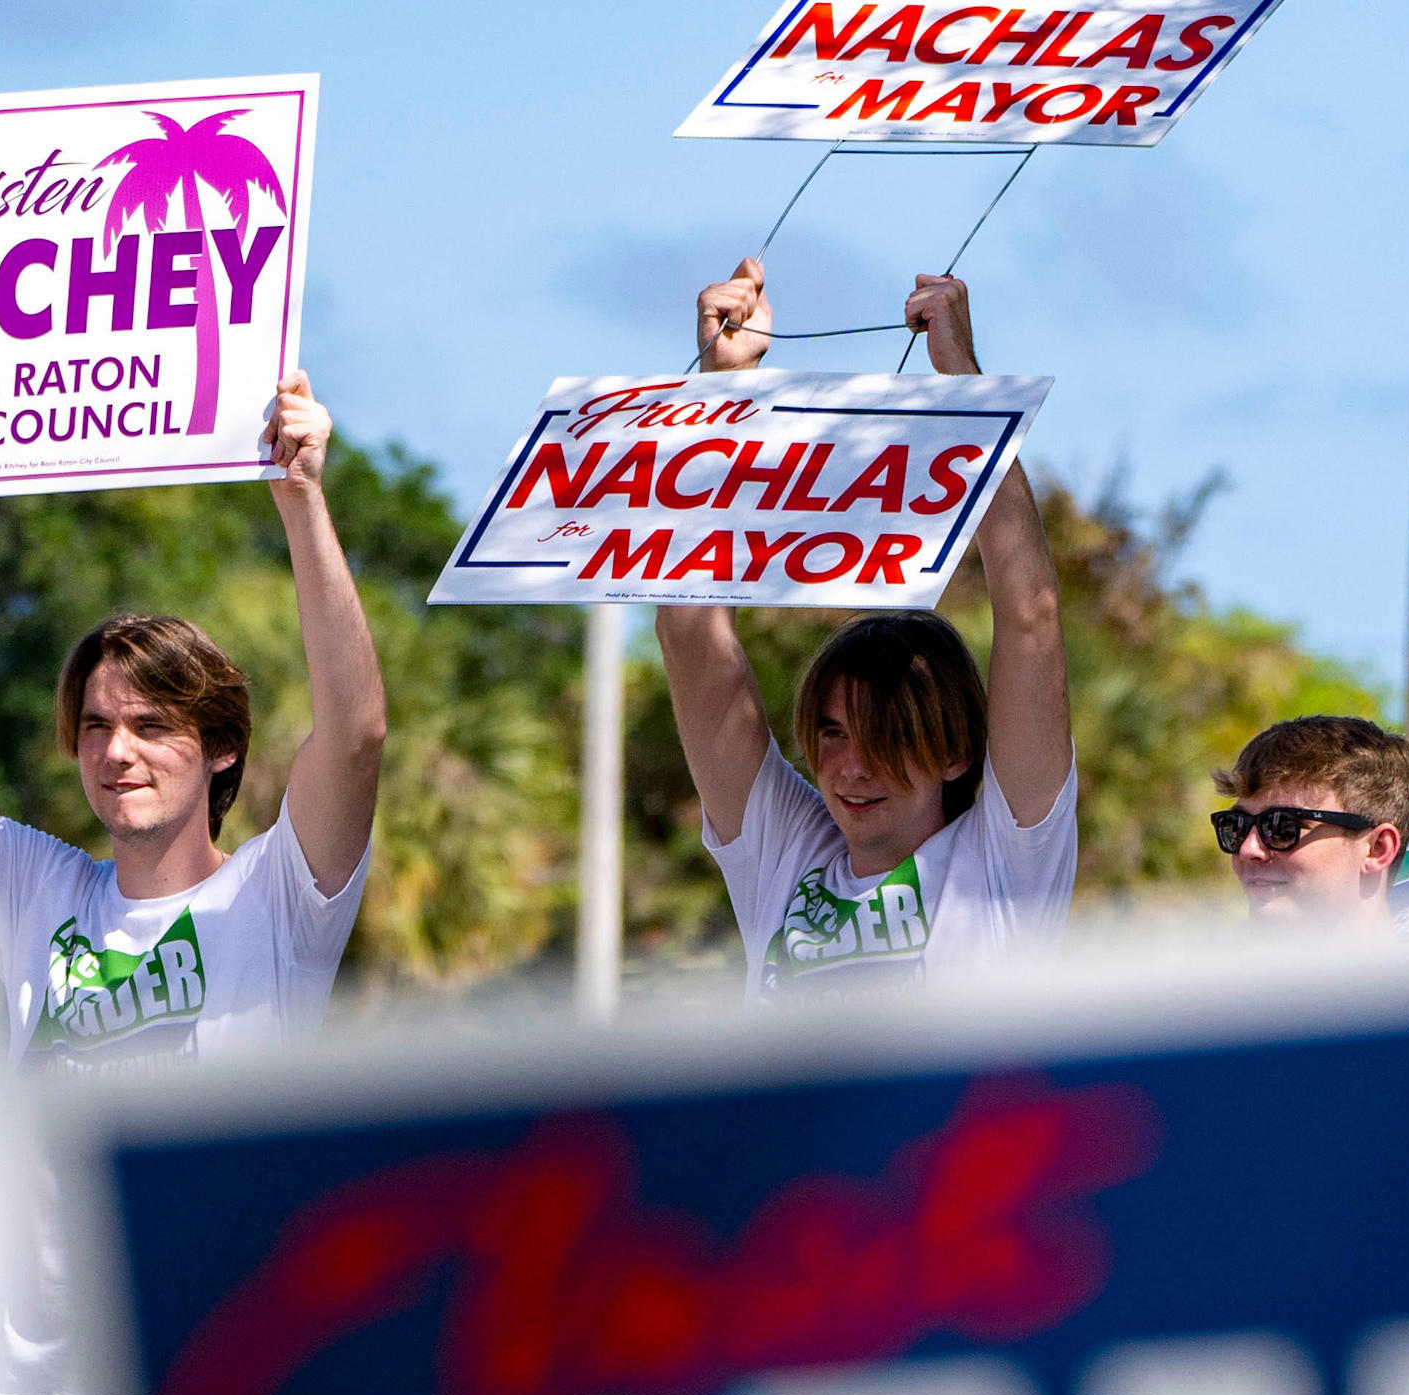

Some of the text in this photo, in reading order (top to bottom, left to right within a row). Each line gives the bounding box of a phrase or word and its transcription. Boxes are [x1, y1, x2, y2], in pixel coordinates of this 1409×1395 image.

[770, 2, 1237, 71] NACHLAS
[825, 79, 1161, 126] MAYOR
[14, 354, 161, 397] RATON
[566, 381, 762, 441] Fran
[4, 462, 28, 471] Ritchey
[79, 457, 93, 465] City
[506, 438, 984, 515] NACHLAS
[538, 521, 923, 585] for MAYOR
